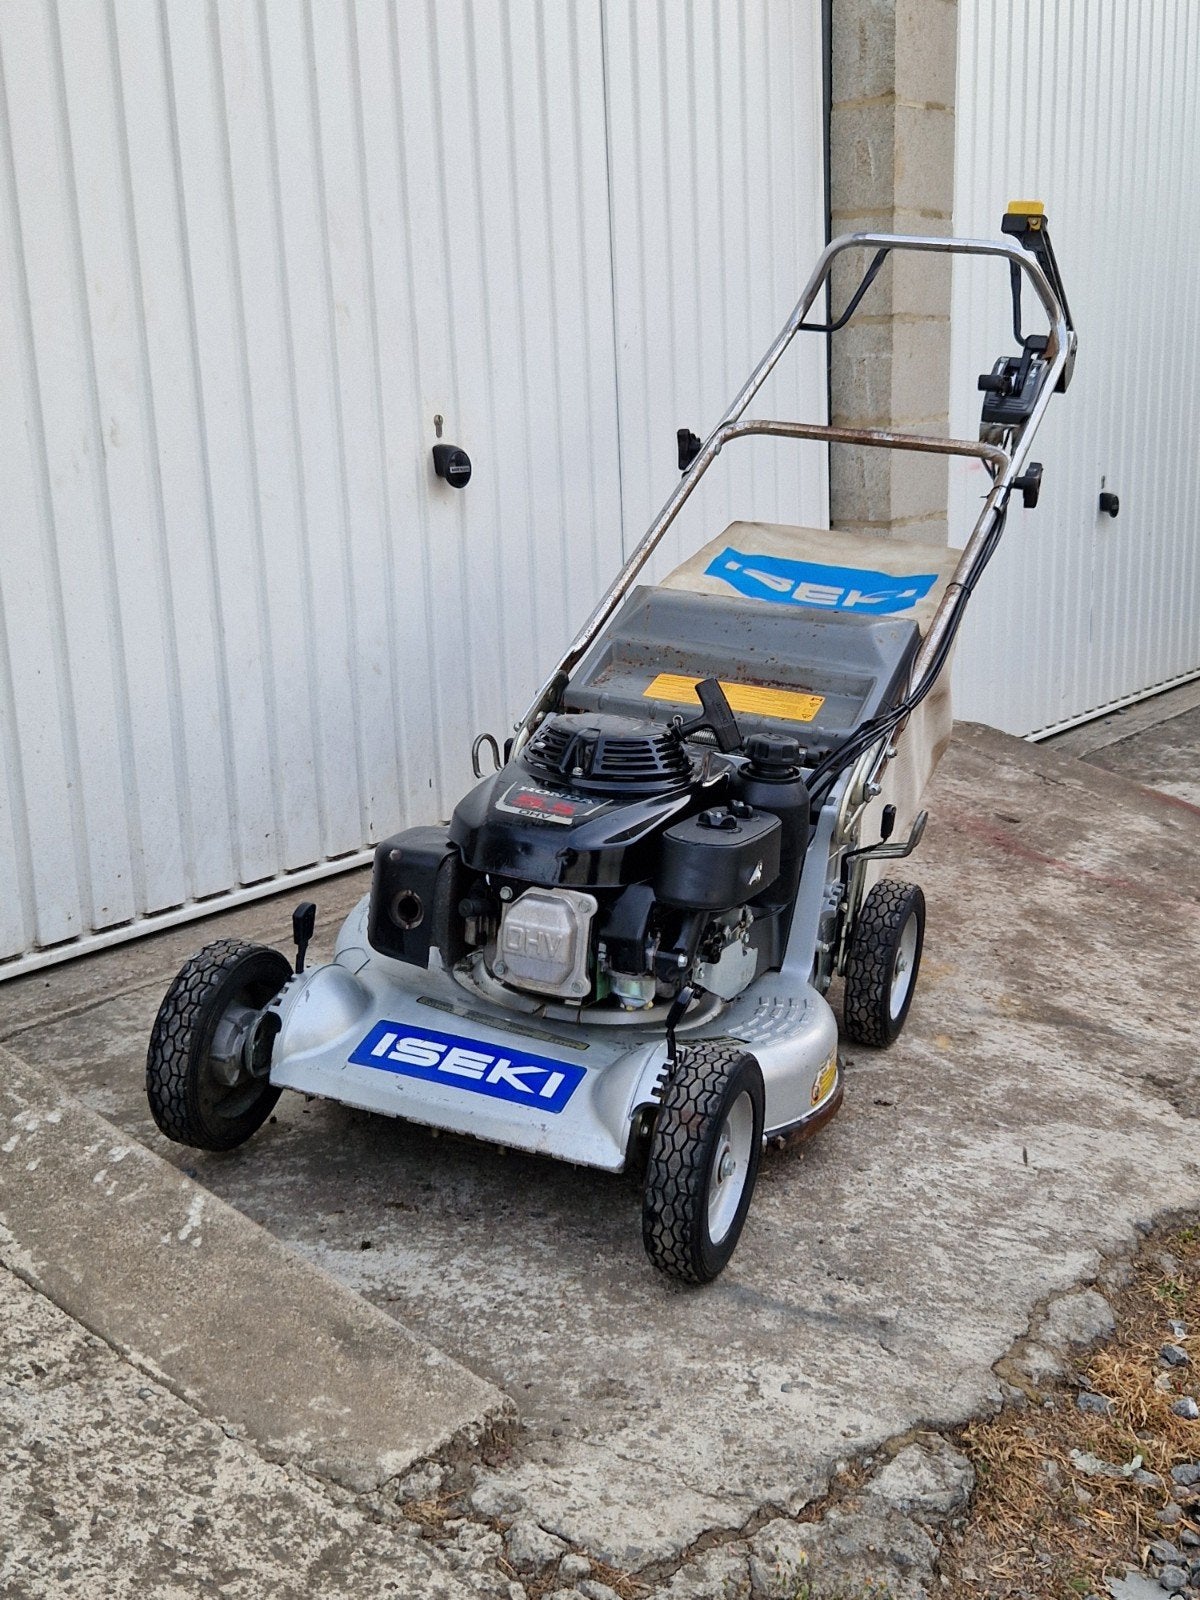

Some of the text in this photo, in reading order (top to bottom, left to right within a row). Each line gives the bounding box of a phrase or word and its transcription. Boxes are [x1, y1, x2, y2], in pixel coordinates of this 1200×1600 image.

[518, 786, 594, 805] HONDA
[518, 808, 552, 819] OHV
[505, 925, 562, 957] OHV
[370, 1032, 565, 1098] ISEKI
